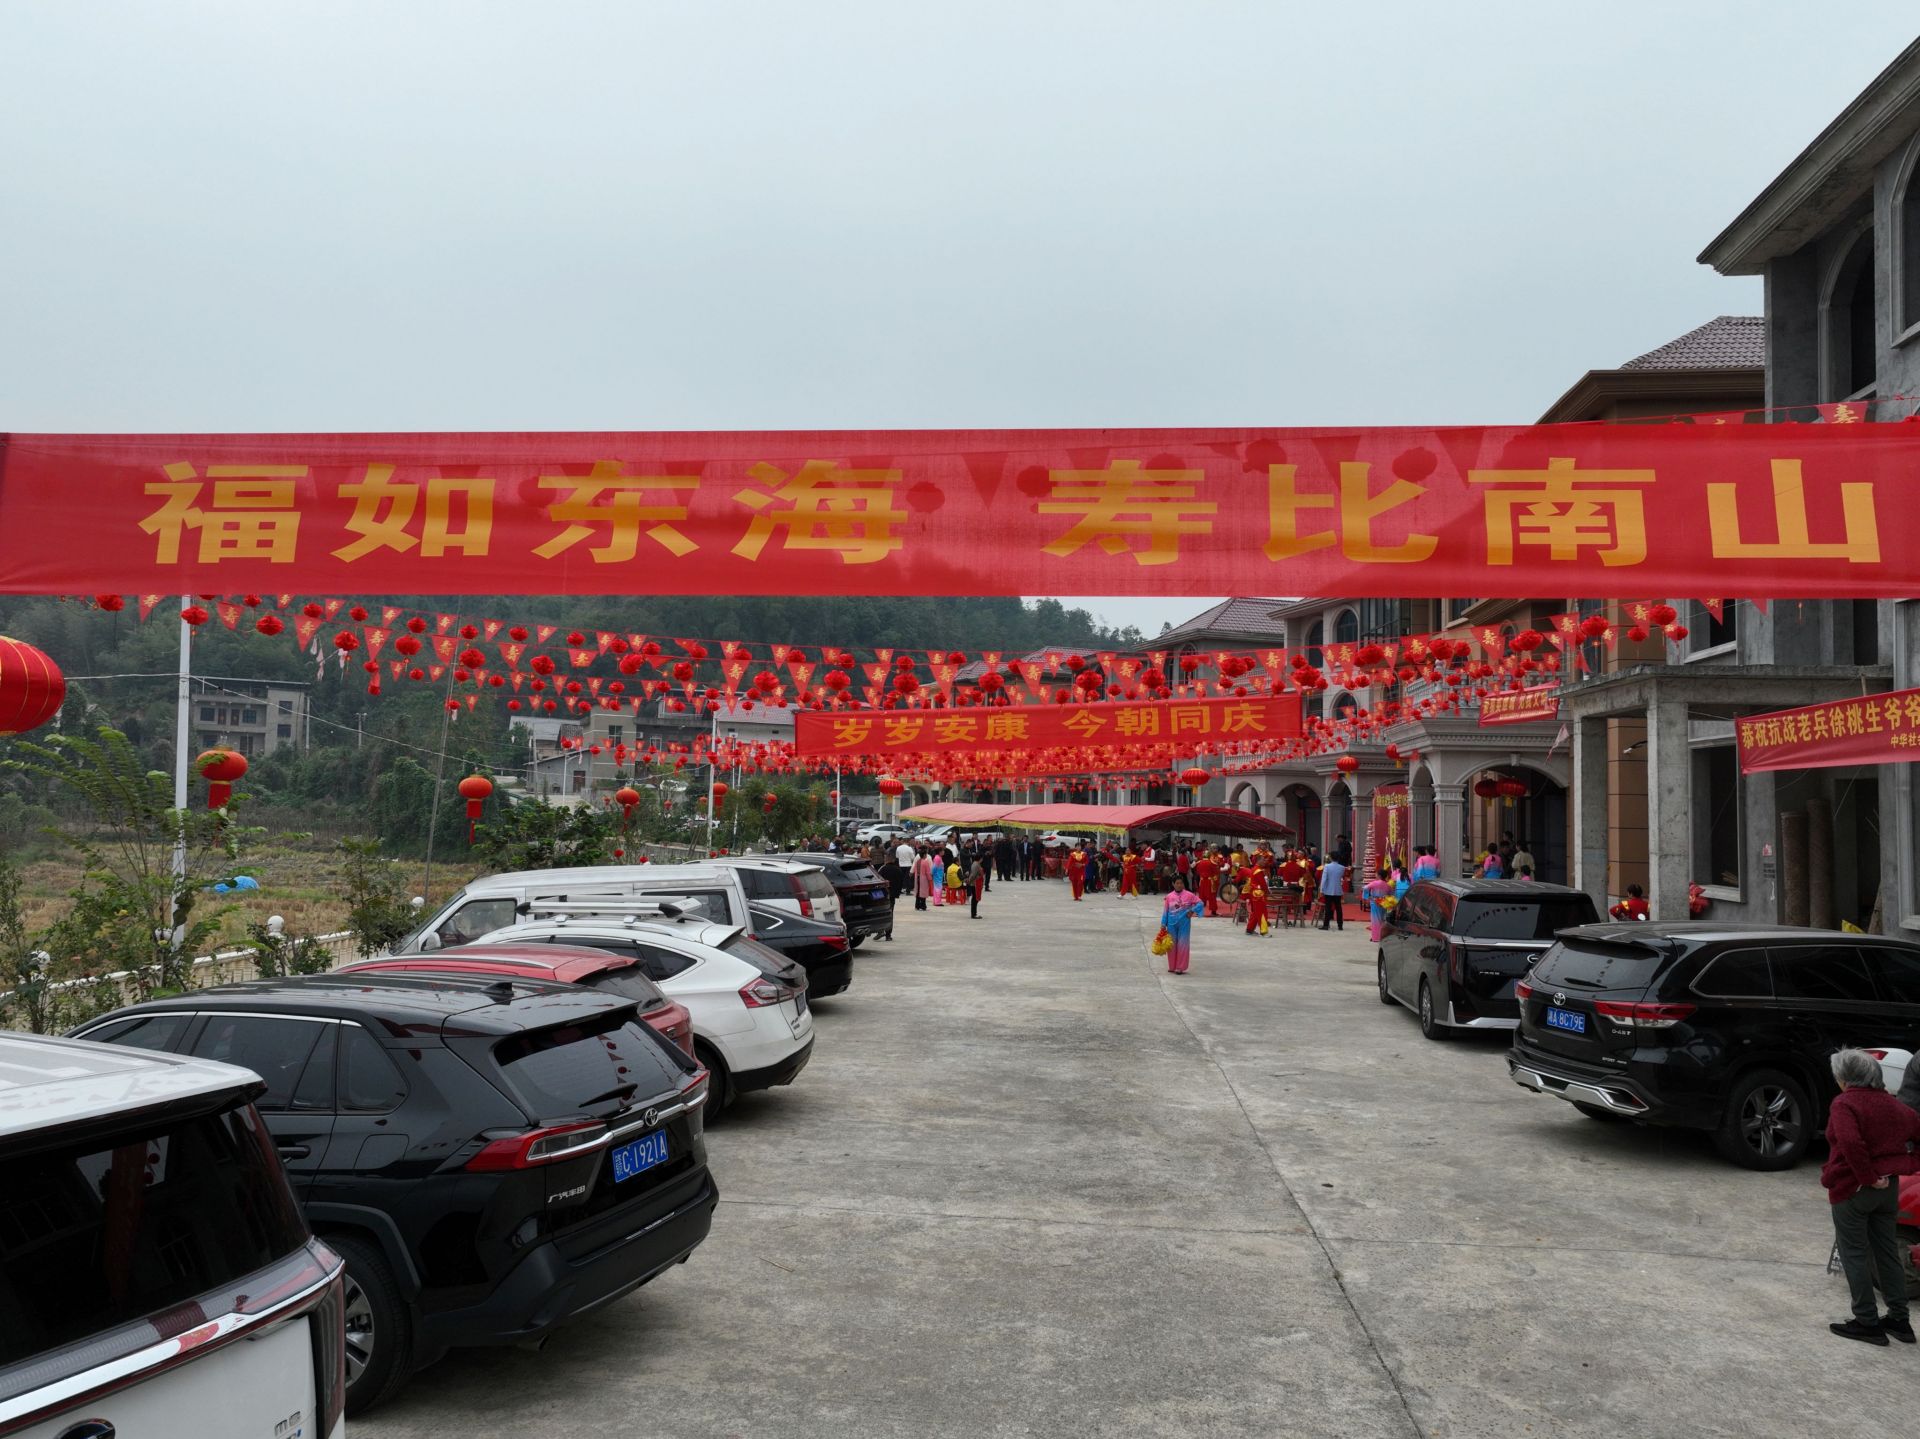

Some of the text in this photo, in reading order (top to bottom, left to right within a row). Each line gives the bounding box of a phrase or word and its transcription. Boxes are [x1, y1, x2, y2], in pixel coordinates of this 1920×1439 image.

[139, 459, 908, 565] 福如东海
[1038, 457, 1881, 566] 寿比南山
[224, 607, 238, 623] 寿
[1634, 605, 1648, 620] 寿
[301, 621, 314, 635] 寿
[1561, 617, 1575, 632] 寿
[370, 631, 383, 646] 寿
[1483, 630, 1496, 645] 寿
[439, 640, 451, 655] 寿
[507, 645, 519, 661] 寿
[1411, 639, 1424, 653] 寿
[575, 653, 588, 664] 寿
[1266, 652, 1280, 668] 寿
[1339, 646, 1352, 662] 寿
[729, 663, 742, 679] 寿
[796, 666, 810, 682] 寿
[872, 667, 886, 682] 寿
[939, 666, 953, 682] 寿
[1027, 665, 1041, 680] 寿
[1120, 662, 1134, 677] 寿
[1062, 703, 1267, 738] 今朝同庆
[833, 711, 1032, 748] 岁岁安康
